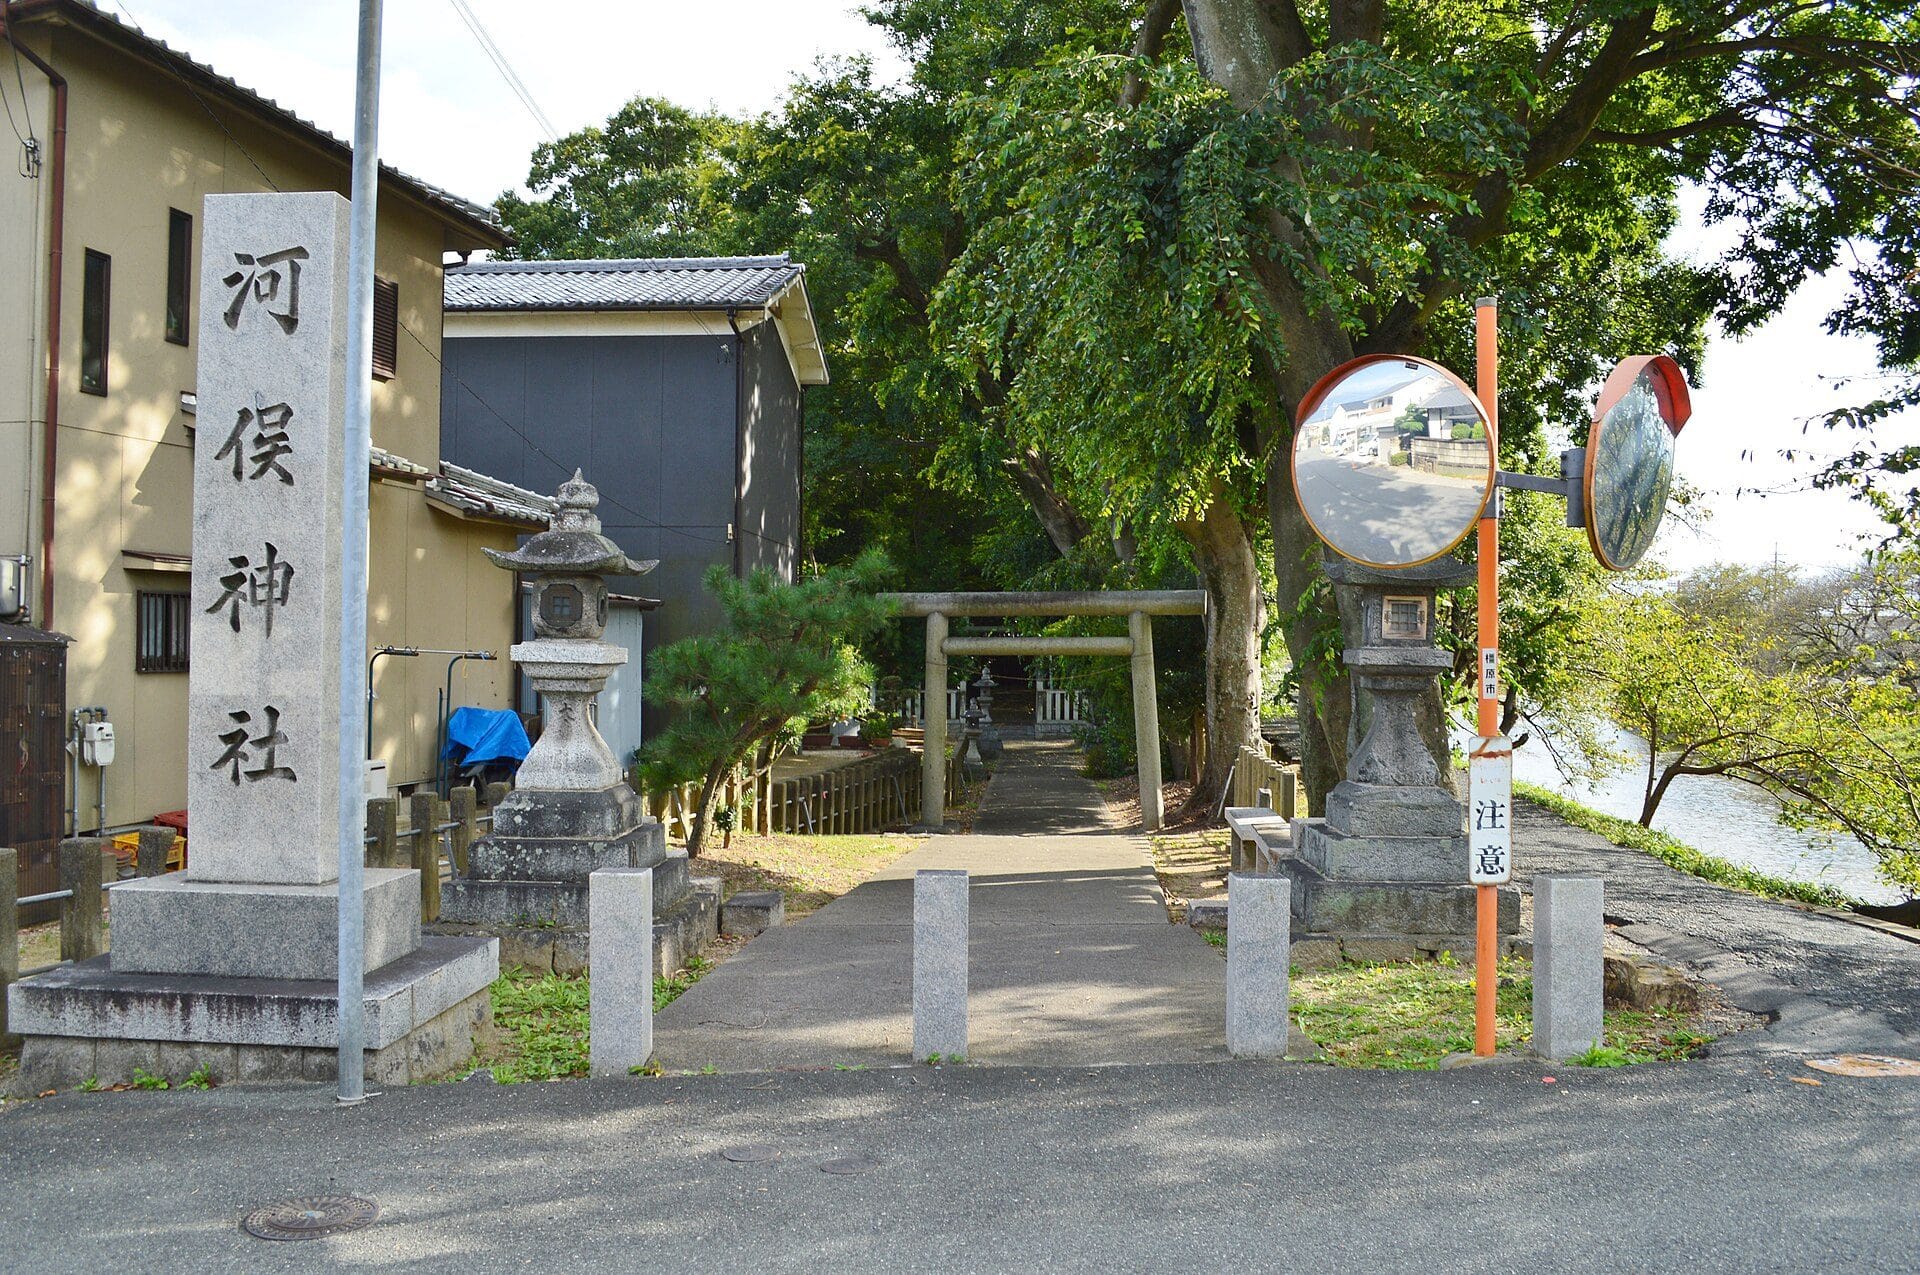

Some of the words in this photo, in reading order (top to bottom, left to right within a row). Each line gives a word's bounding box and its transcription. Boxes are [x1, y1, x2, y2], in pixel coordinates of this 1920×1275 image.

[206, 245, 310, 787] 河俣神社
[1475, 799, 1506, 876] 注意
